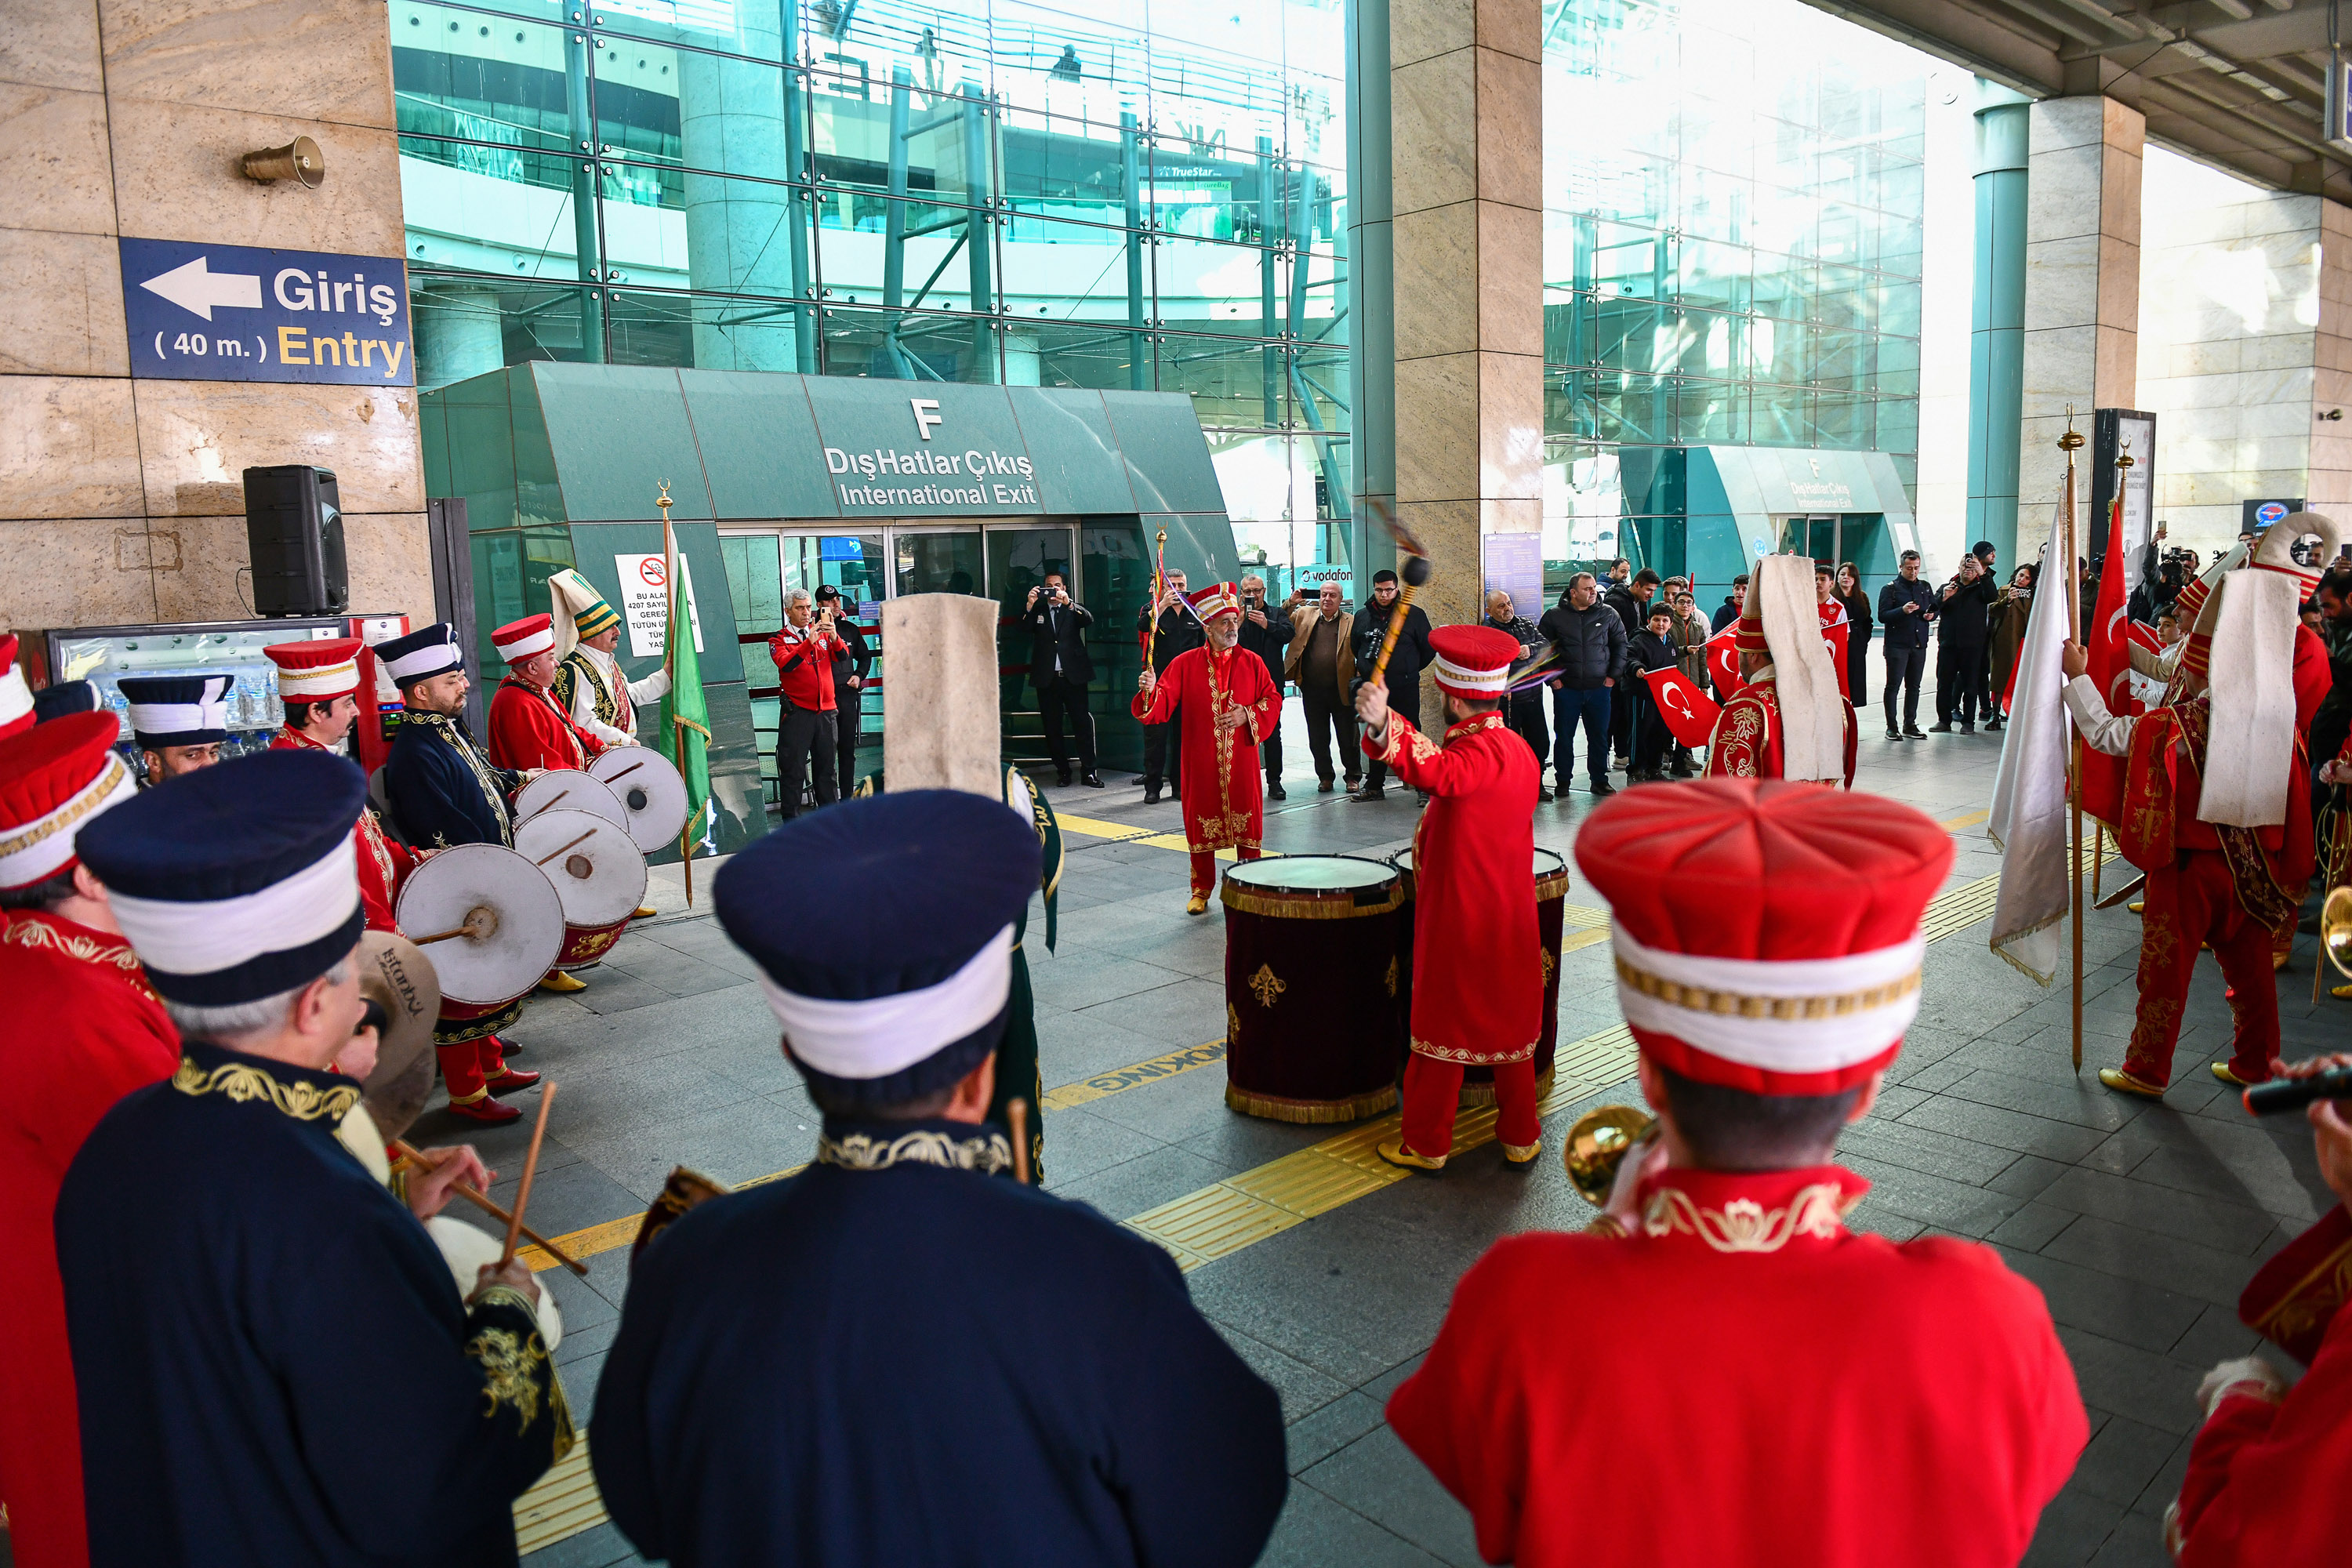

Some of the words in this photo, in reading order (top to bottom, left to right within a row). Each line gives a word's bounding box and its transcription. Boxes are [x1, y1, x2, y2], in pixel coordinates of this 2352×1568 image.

[1171, 167, 1213, 176] TrueStar
[274, 268, 397, 327] Giriş
[278, 326, 405, 379] Entry
[910, 398, 942, 440] F
[964, 450, 1033, 481] Çıkış
[1808, 458, 1820, 479] F
[840, 484, 989, 505] International
[993, 485, 1036, 504] Exit
[1797, 499, 1839, 508] International
[1839, 499, 1853, 508] Exit
[1312, 568, 1352, 583] vodafon
[1087, 1042, 1227, 1091] MOKING
